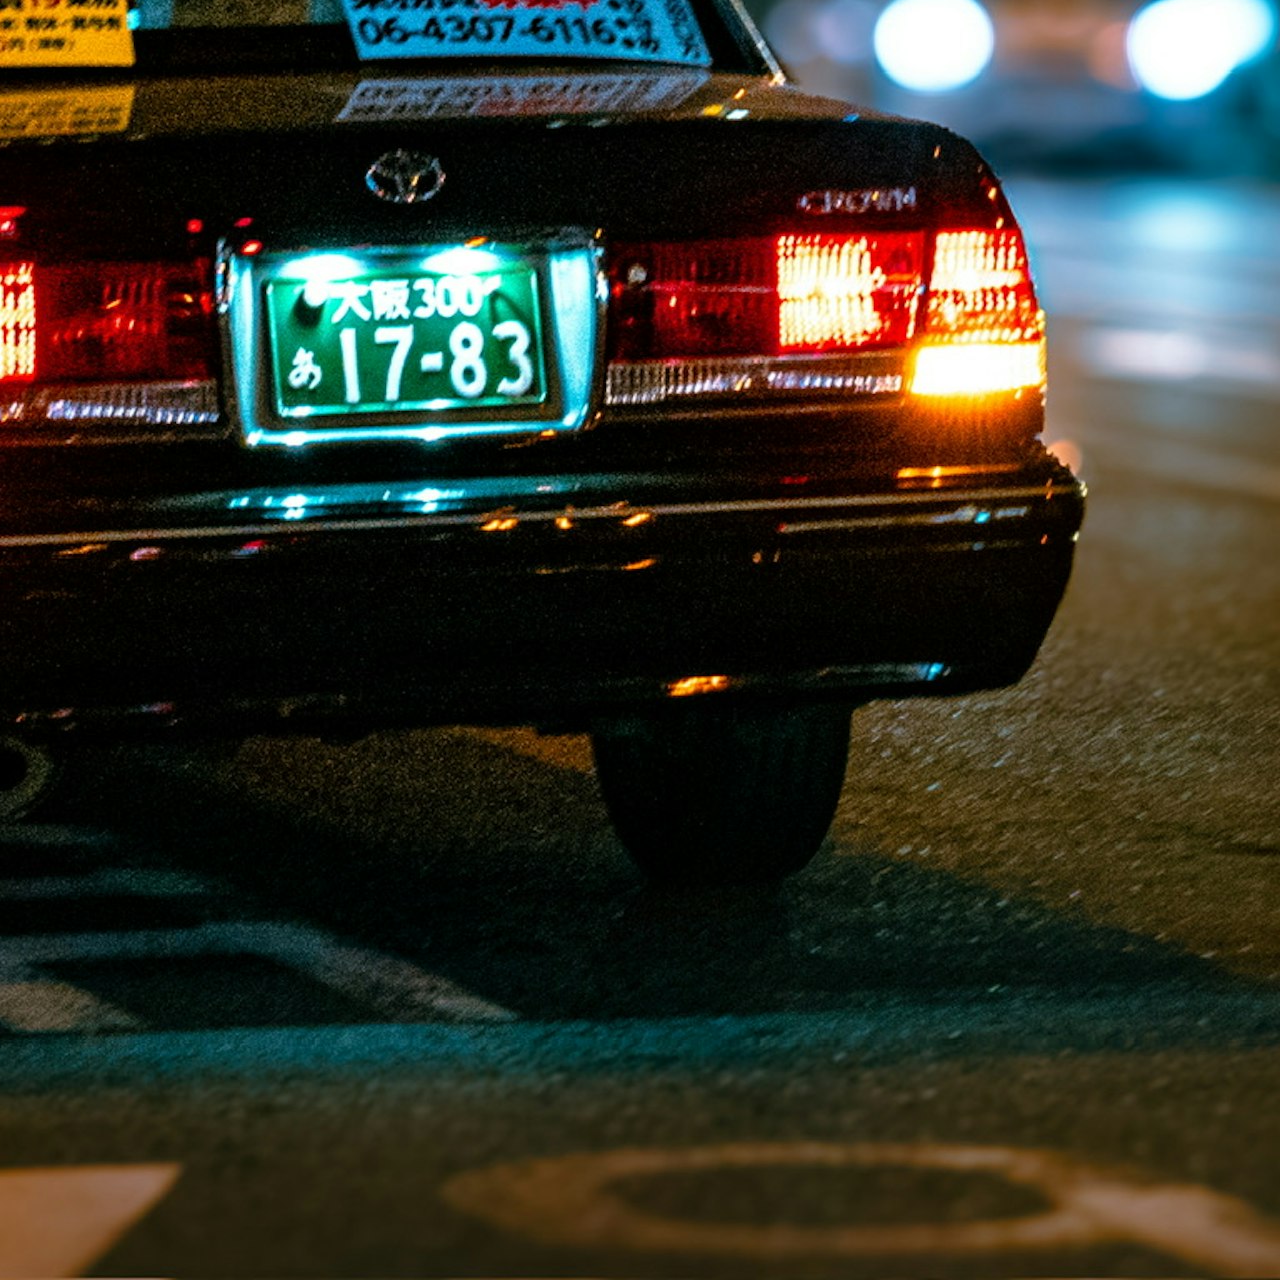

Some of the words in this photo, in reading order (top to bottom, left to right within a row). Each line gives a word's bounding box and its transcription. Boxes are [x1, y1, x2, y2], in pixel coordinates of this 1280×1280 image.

[357, 16, 617, 47] 06-4307-6116
[288, 347, 322, 389] あ
[339, 321, 534, 404] 17-83
